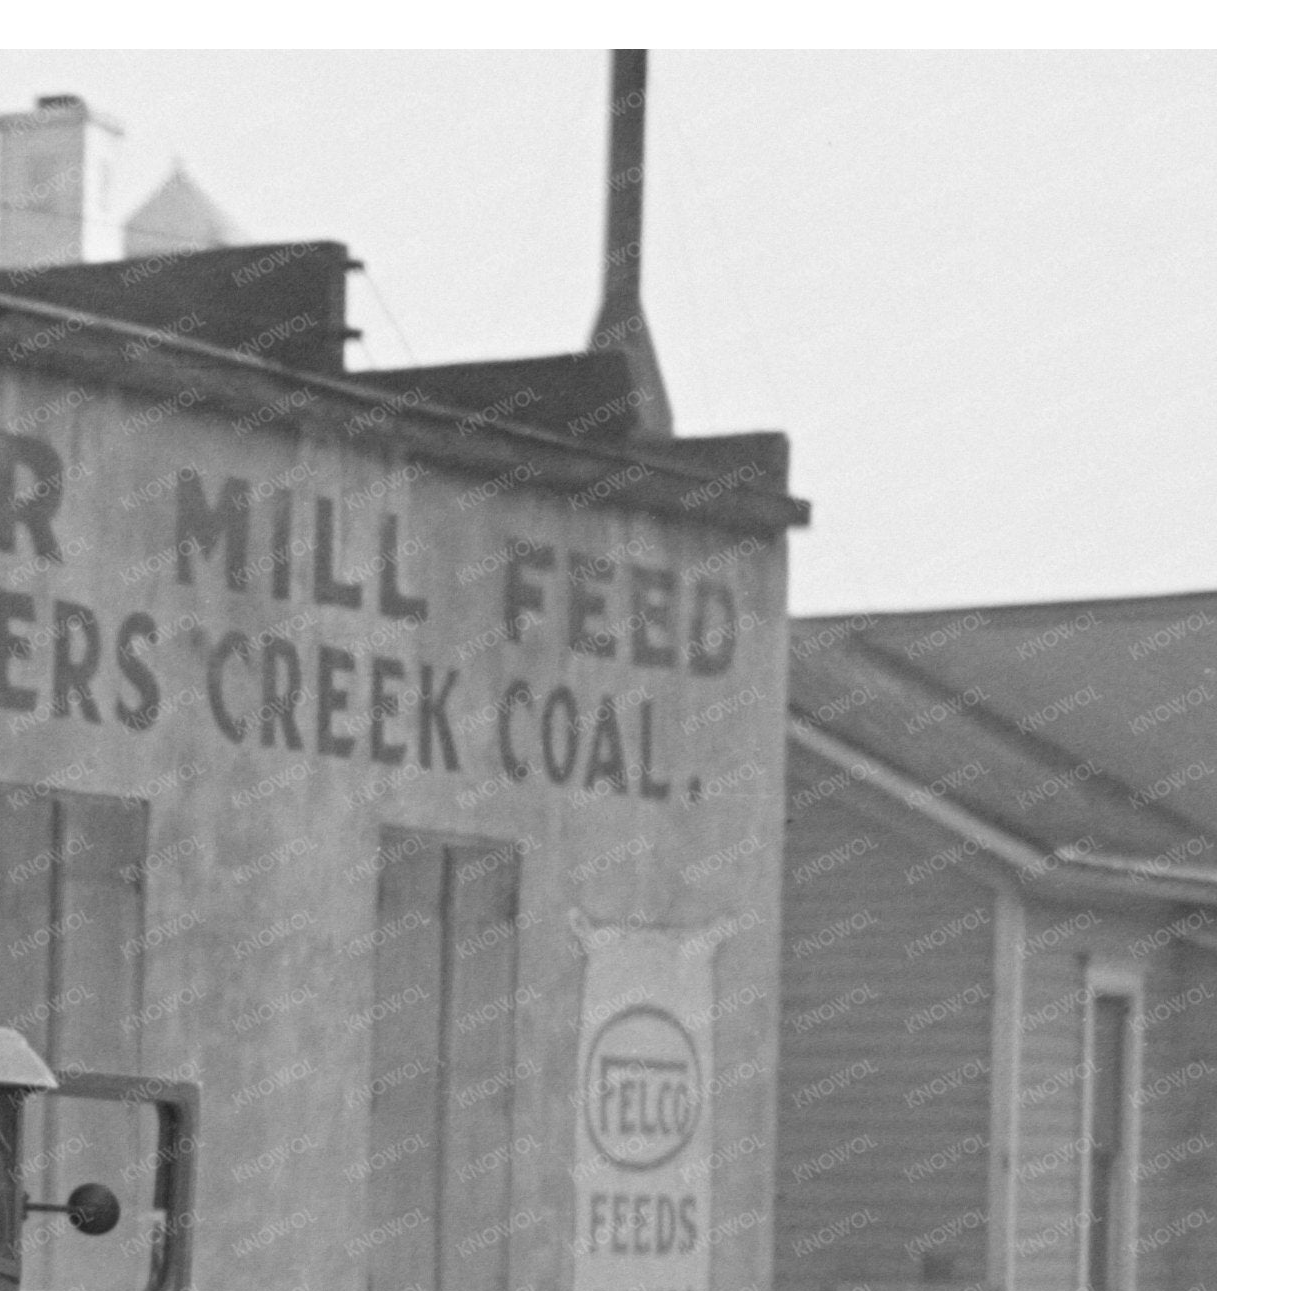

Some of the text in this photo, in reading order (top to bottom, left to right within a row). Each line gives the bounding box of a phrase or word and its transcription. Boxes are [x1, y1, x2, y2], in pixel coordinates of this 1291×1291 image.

[175, 467, 429, 623] MILL
[502, 535, 739, 678] FEED
[207, 630, 461, 773] CREEK
[498, 678, 703, 803] COAL.
[598, 1054, 690, 1136] FELCO
[588, 1190, 699, 1257] FEEDS
